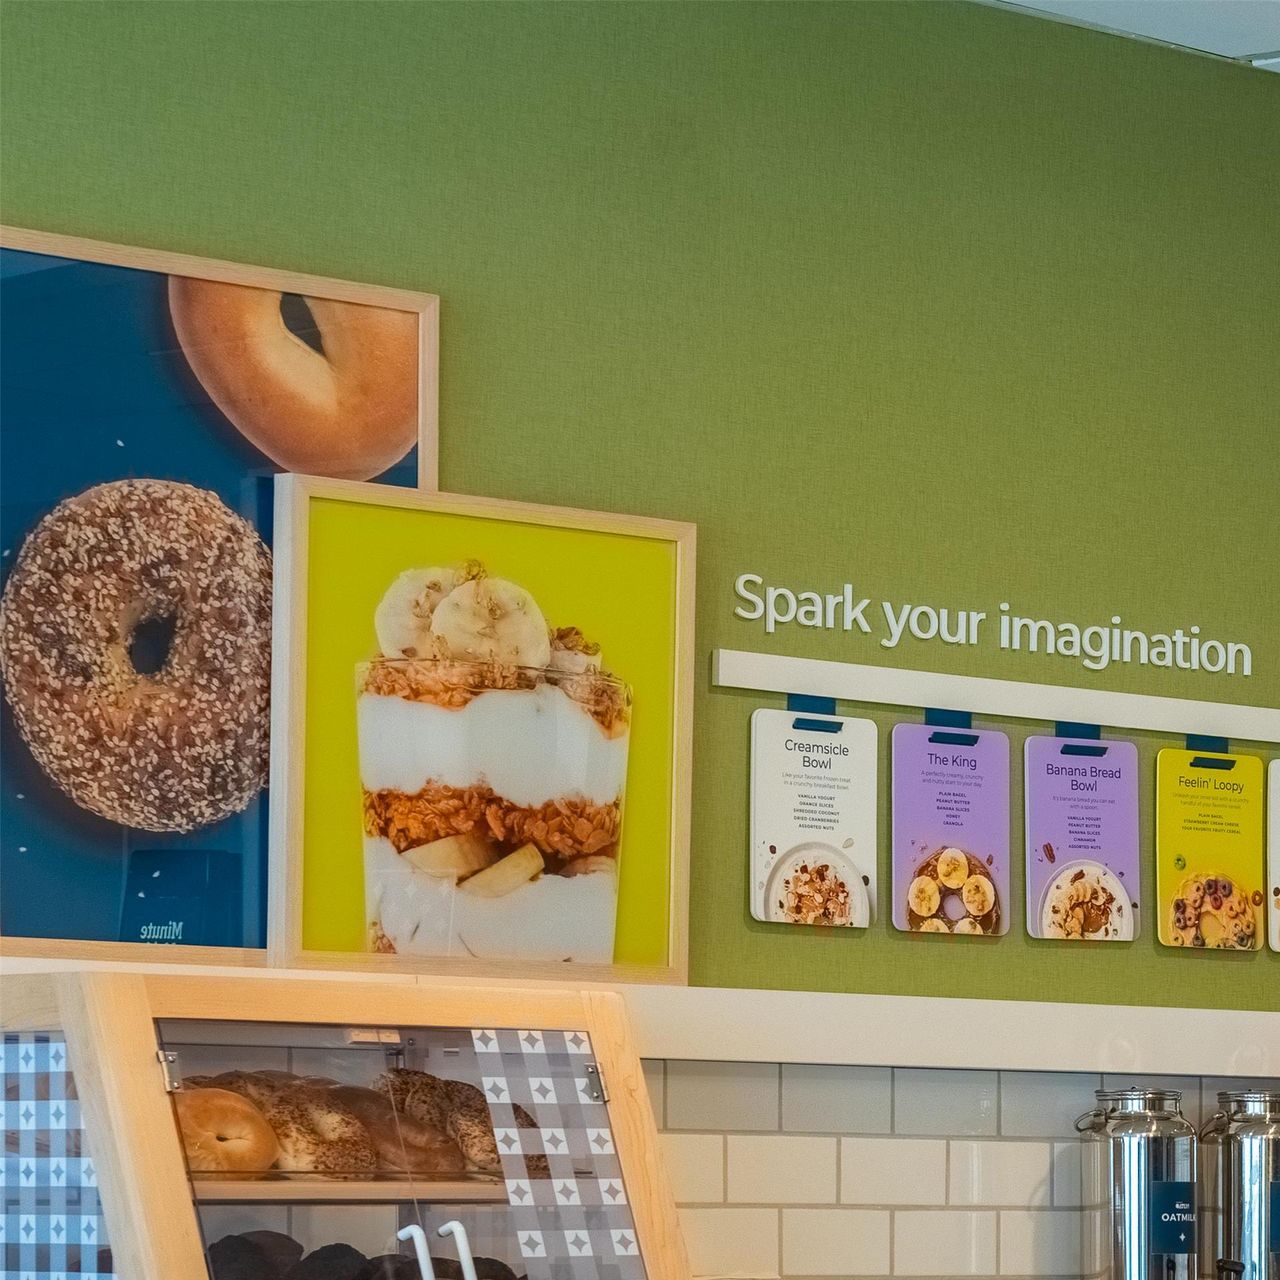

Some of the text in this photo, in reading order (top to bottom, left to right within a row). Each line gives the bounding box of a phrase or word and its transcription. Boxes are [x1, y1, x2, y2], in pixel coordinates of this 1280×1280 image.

[734, 573, 1253, 676] Spark your imagination
[785, 738, 849, 757] Creamsicle
[802, 755, 832, 769] Bowl
[928, 753, 977, 770] The King
[1046, 763, 1121, 779] Banana Bread
[1071, 779, 1097, 792] Bowl
[1214, 779, 1244, 794] Loopy
